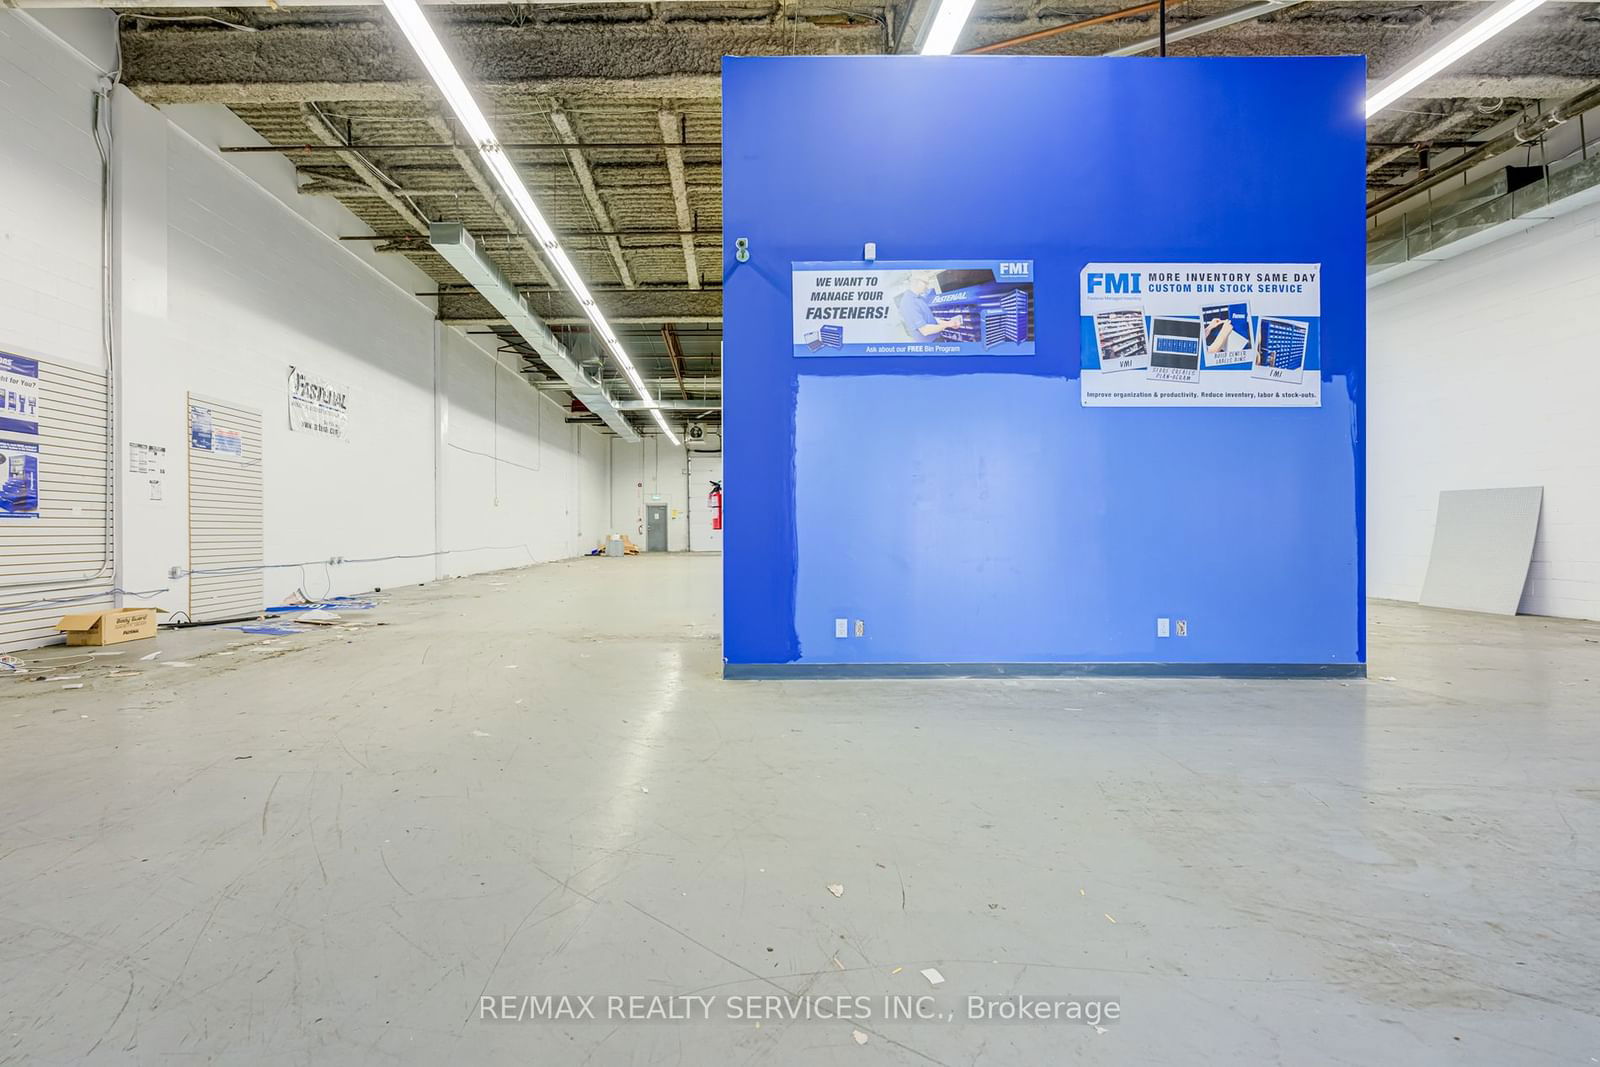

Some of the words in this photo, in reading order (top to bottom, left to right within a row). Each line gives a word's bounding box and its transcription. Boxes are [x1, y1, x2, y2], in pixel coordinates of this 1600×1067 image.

[1000, 263, 1029, 274] FMI
[816, 277, 832, 287] WE
[834, 277, 864, 287] WANT
[865, 277, 879, 287] TO
[1148, 273, 1181, 282] MORE
[1186, 273, 1251, 282] INVENTORY
[1256, 273, 1288, 282] SAME
[1294, 273, 1316, 282] DAY
[1087, 273, 1142, 294] FMI
[1148, 284, 1192, 293] CUSTOM
[1196, 284, 1215, 293] BIN
[1219, 284, 1254, 293] STOCK
[1258, 284, 1303, 293] SERVICE
[810, 291, 855, 301] MANAGE
[857, 291, 884, 301] YOUR
[805, 307, 890, 320] FASTENERS!
[935, 346, 960, 354] Program
[1113, 391, 1152, 399] organization
[1160, 391, 1199, 399] productivity.
[1225, 391, 1256, 399] inventory,
